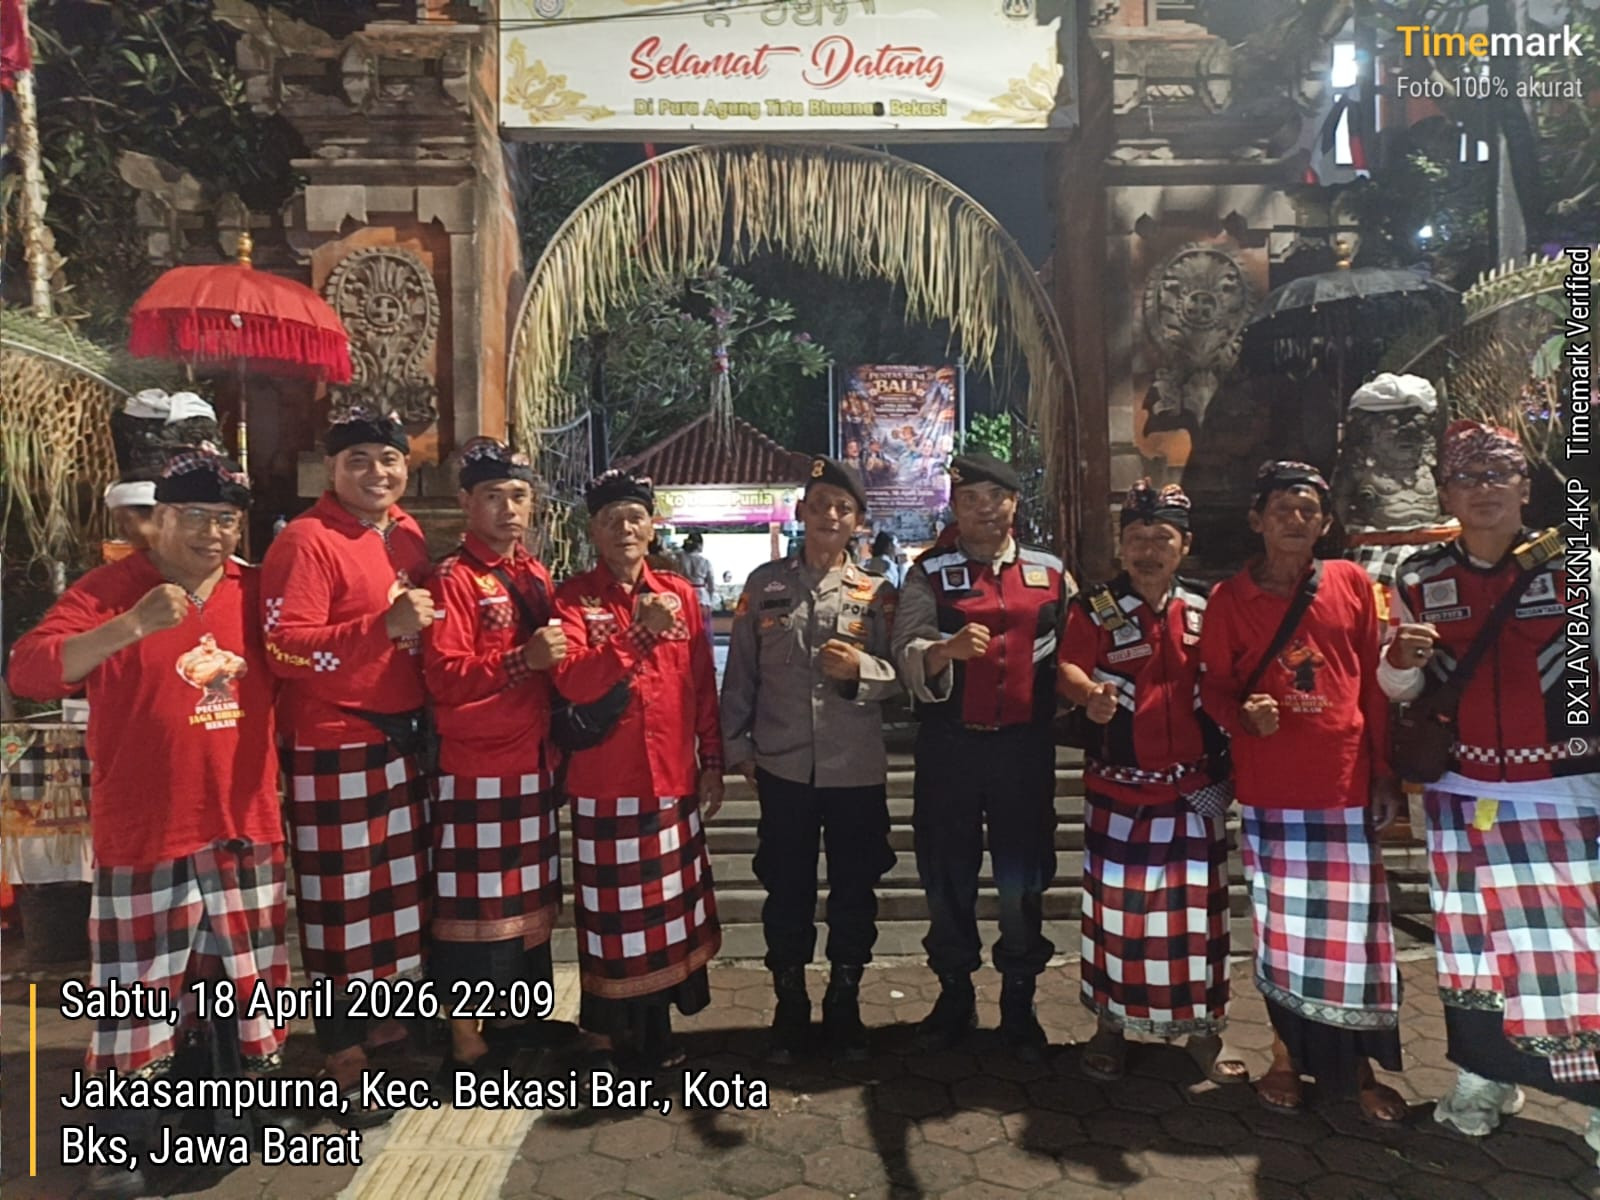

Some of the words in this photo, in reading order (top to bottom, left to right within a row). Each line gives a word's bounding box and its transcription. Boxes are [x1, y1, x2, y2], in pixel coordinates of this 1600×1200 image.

[630, 36, 800, 80] Selamat
[802, 35, 944, 88] Datang
[633, 98, 654, 116] Di
[658, 99, 700, 116] Pura
[703, 98, 761, 120] Agung
[890, 98, 948, 117] Bekasi
[873, 379, 918, 393] BALI
